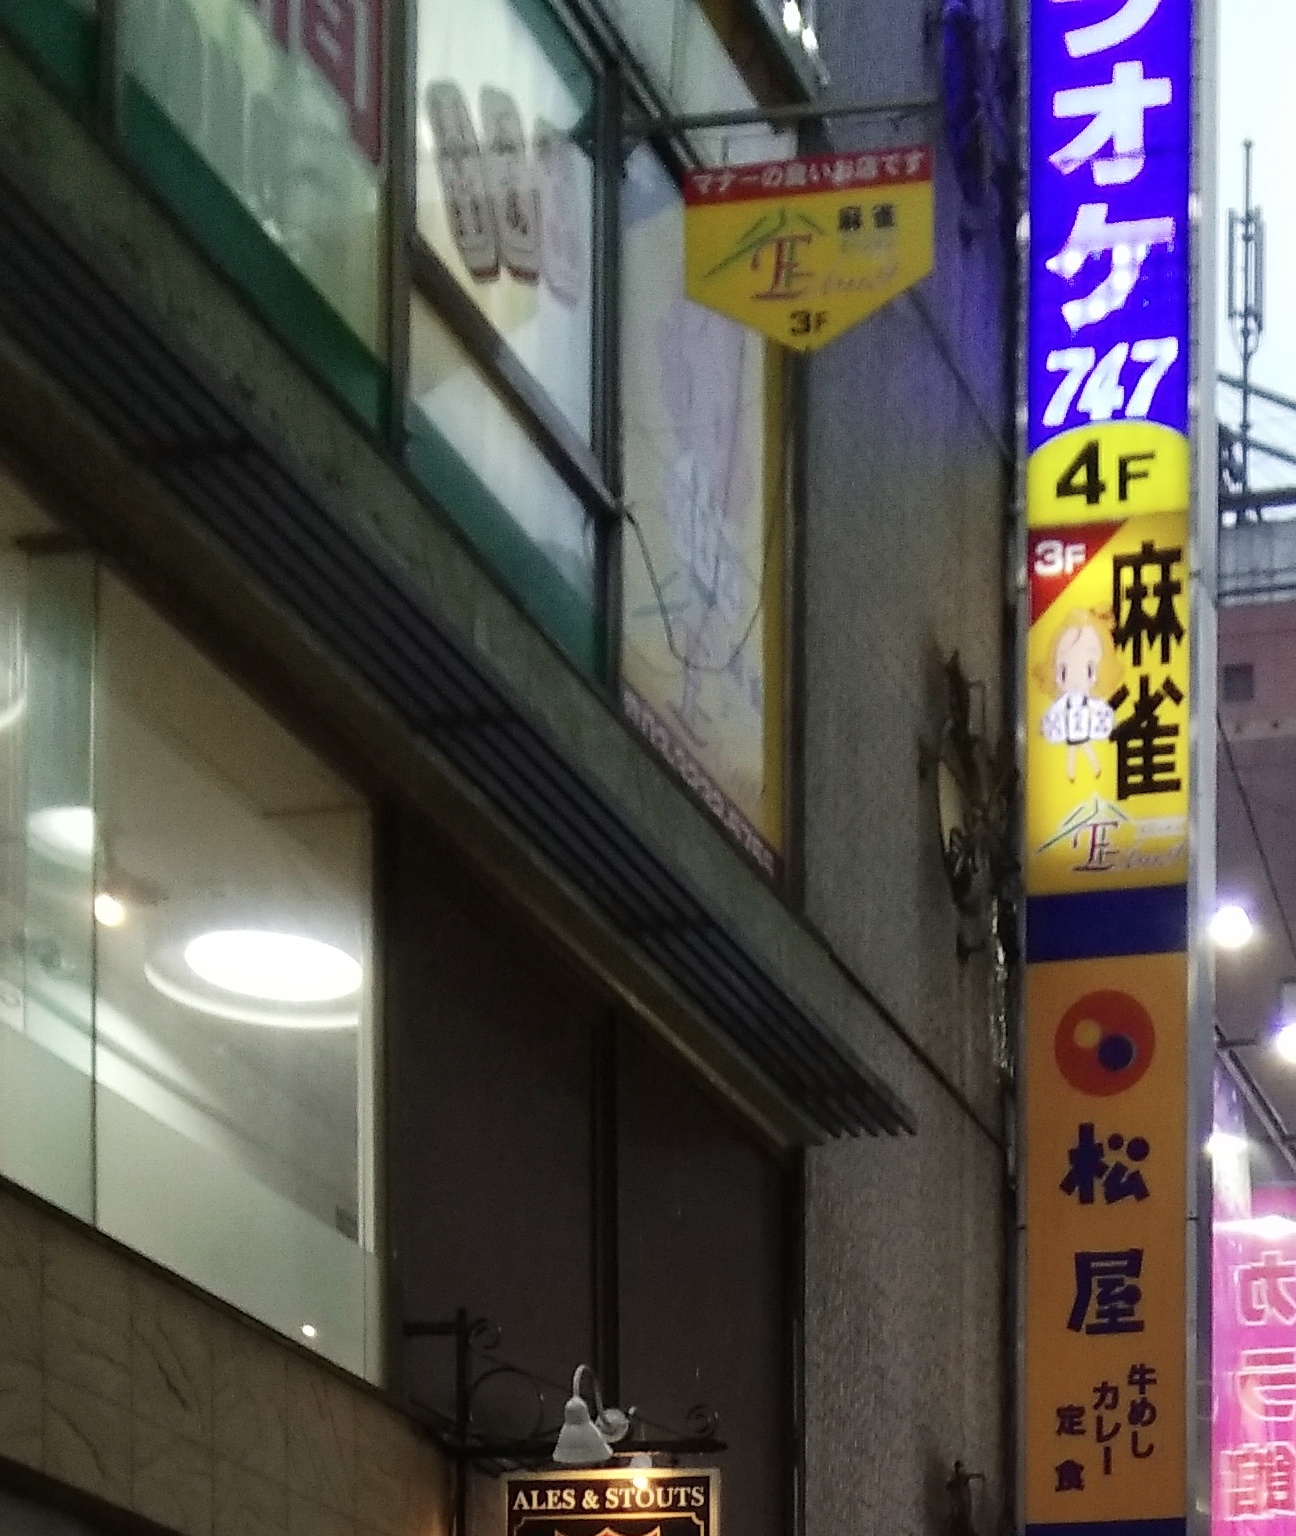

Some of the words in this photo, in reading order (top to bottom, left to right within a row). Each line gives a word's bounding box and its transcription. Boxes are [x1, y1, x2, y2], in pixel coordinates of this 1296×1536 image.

[790, 310, 829, 337] 3F
[1043, 337, 1178, 428] 747
[1055, 439, 1155, 506] 4F
[1033, 539, 1088, 578] 3F
[1109, 540, 1184, 801] 麻雀
[1059, 1122, 1150, 1335] 松屋
[1055, 1404, 1086, 1493] 定食
[1093, 1381, 1121, 1475] カレー
[1127, 1363, 1158, 1459] 牛めし
[513, 1489, 576, 1511] ALES
[582, 1488, 600, 1510] &
[605, 1485, 706, 1509] STOUTS
